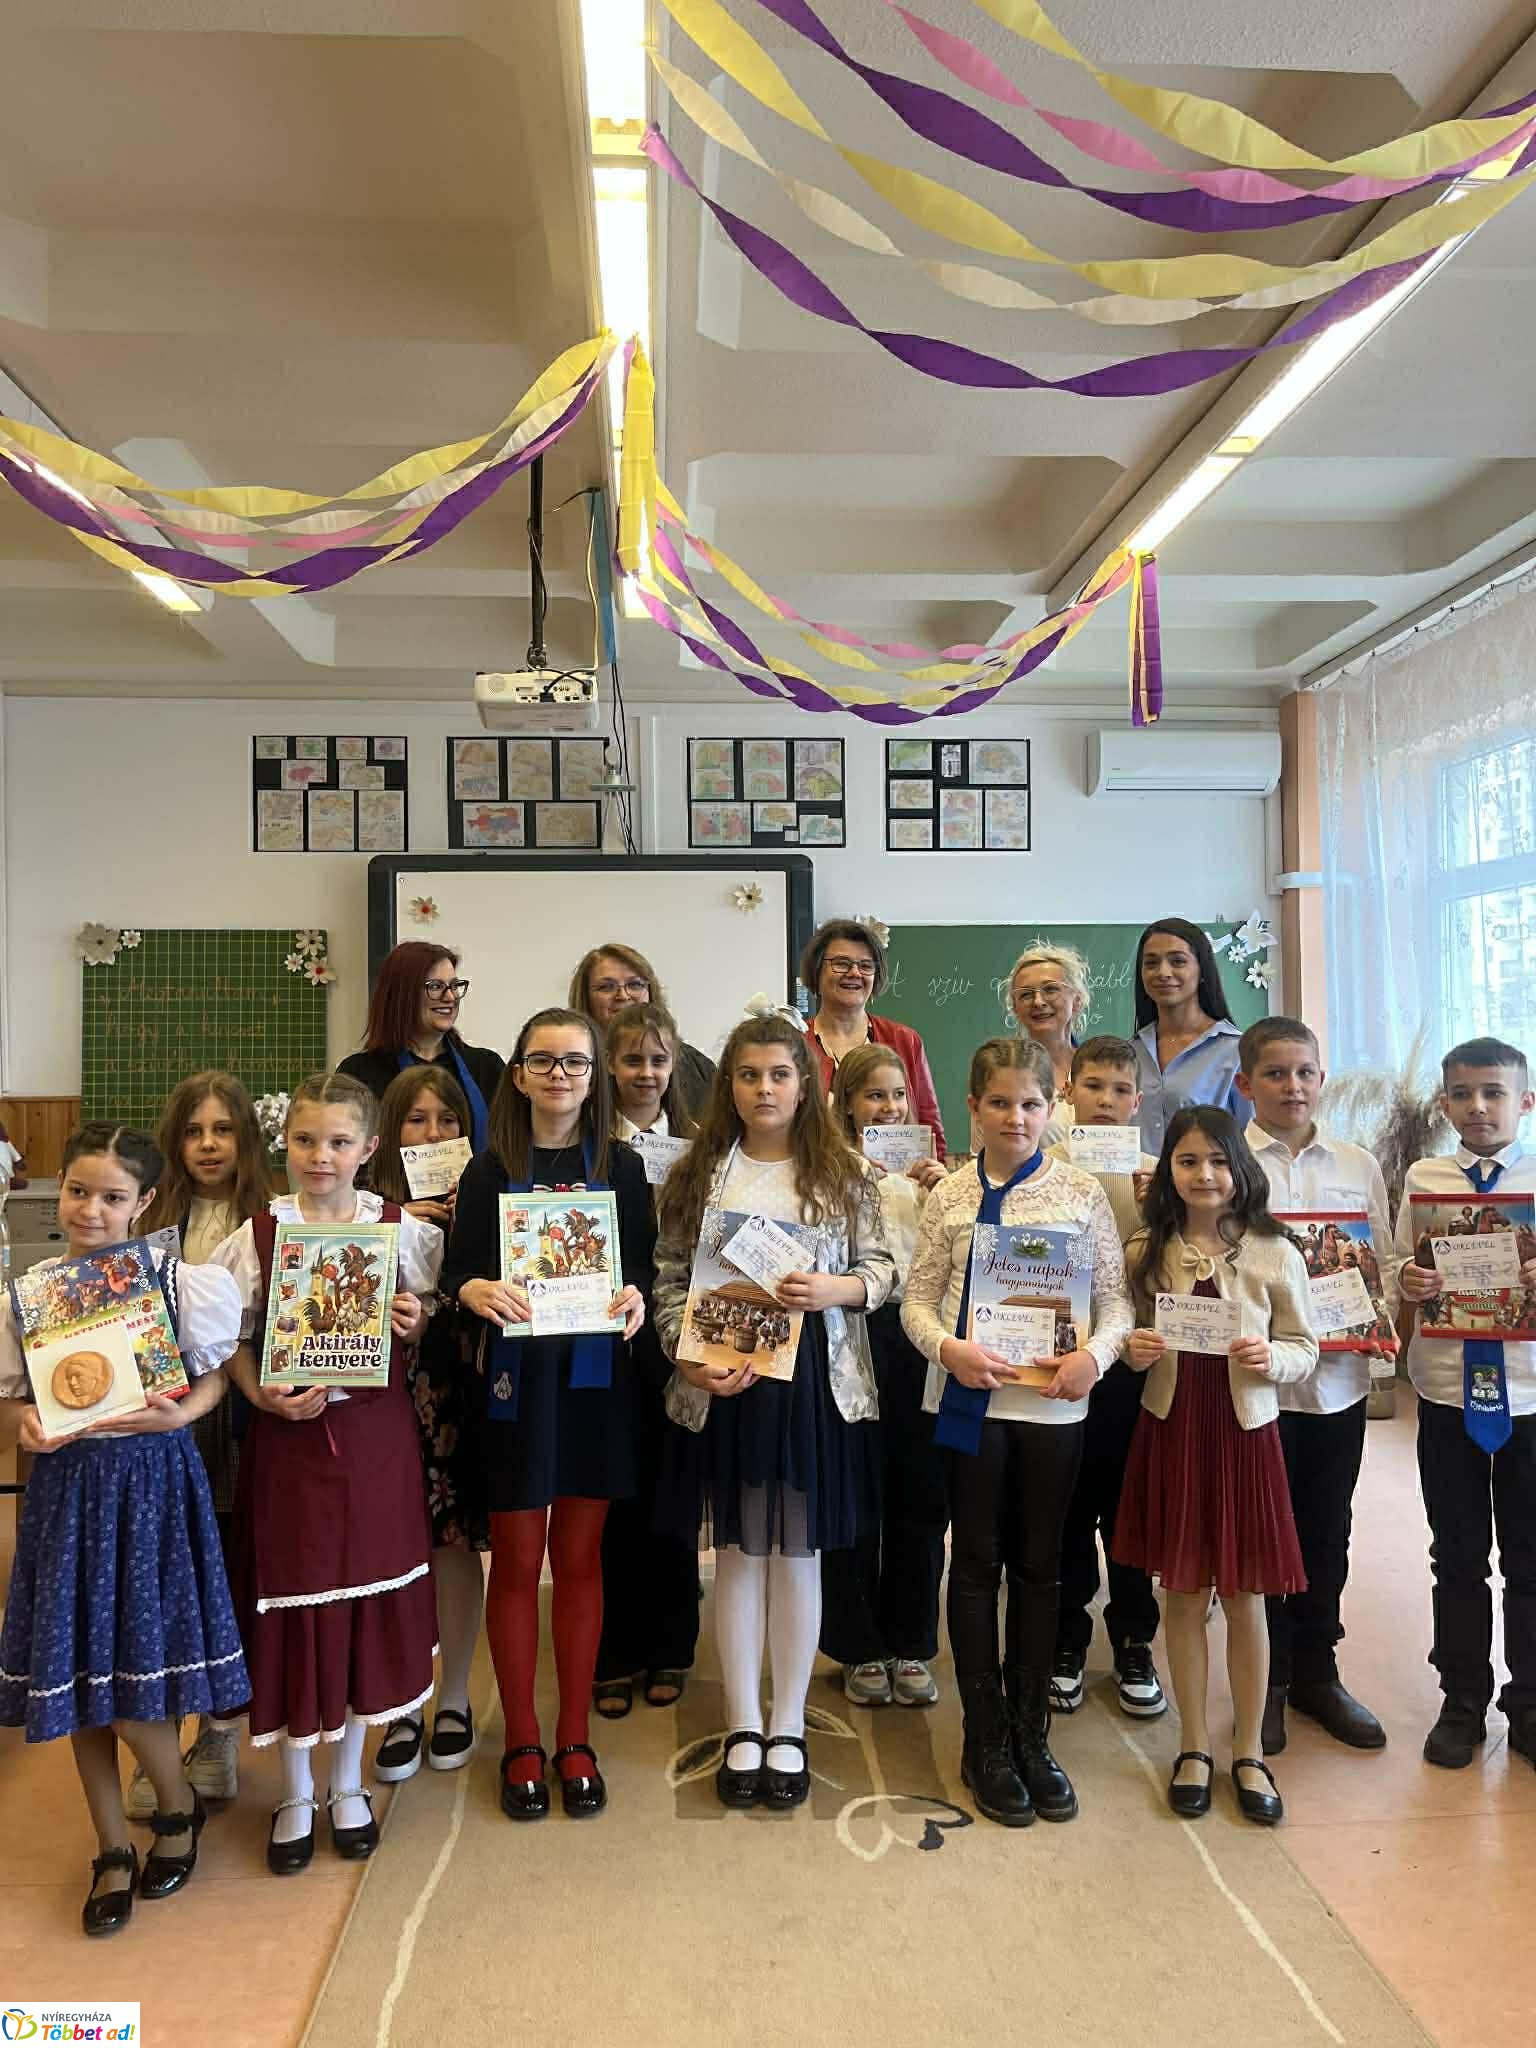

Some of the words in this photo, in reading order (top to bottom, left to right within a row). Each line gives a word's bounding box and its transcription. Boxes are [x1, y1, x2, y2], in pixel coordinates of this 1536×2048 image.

[125, 1314, 158, 1330] MESE
[319, 1333, 382, 1353] király
[298, 1352, 382, 1370] kenyere
